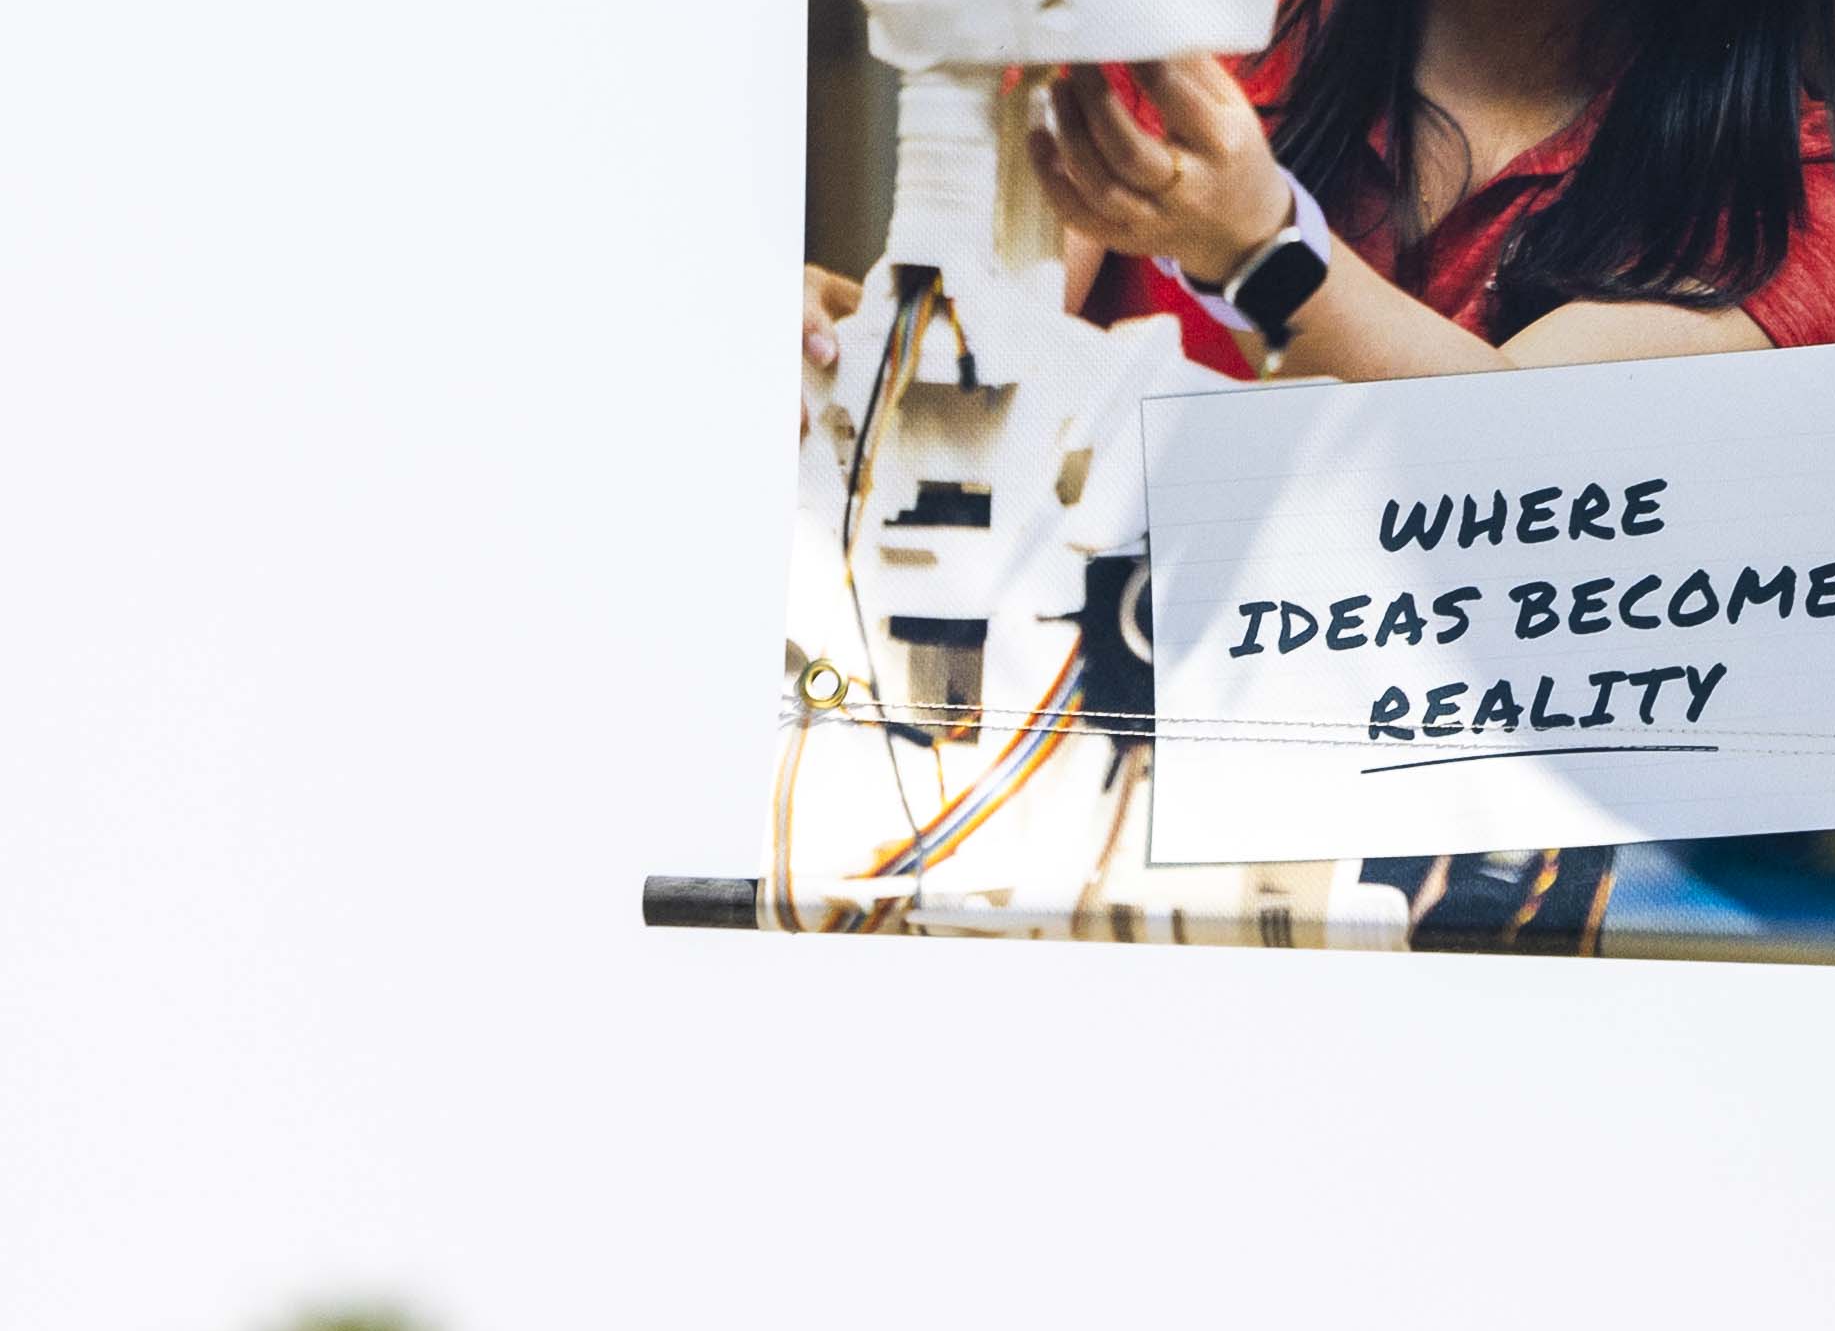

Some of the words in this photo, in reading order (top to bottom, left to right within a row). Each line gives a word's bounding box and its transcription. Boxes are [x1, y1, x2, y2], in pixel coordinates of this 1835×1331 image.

[1379, 478, 1668, 552] WHERE
[1229, 585, 1482, 658] IDEAS
[1368, 662, 1727, 740] REALITY
